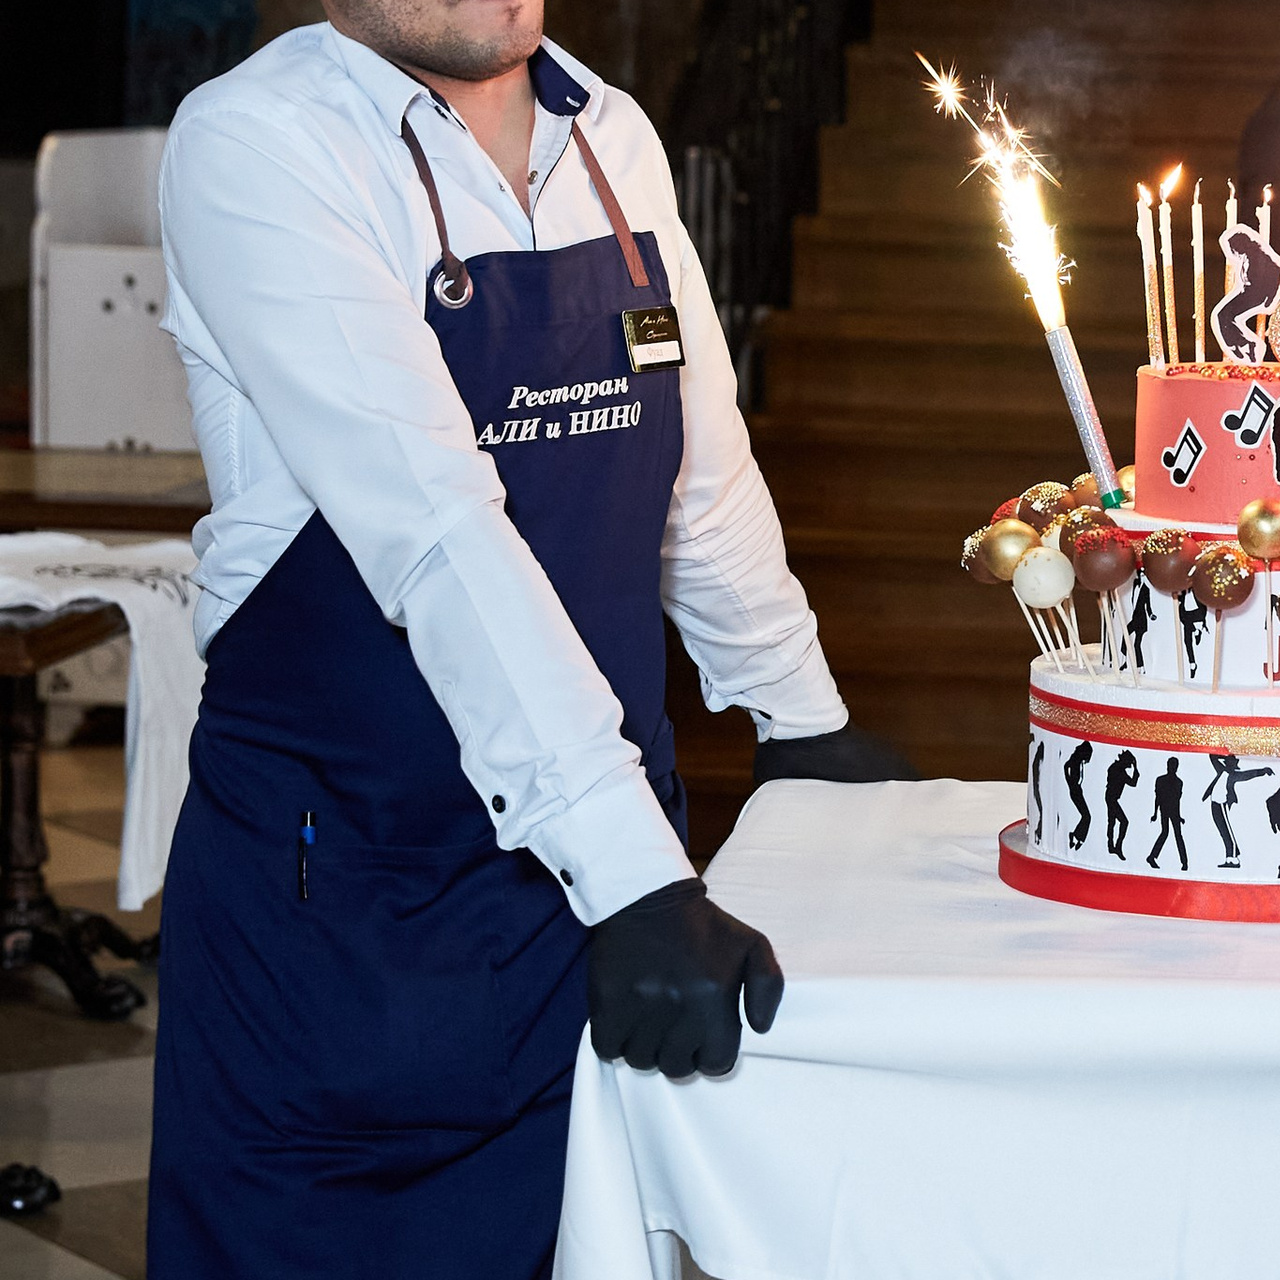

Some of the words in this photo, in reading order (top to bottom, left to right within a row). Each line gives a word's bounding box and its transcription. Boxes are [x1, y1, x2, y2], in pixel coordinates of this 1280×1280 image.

[507, 376, 629, 409] Ресторан
[477, 417, 542, 446] АЛИ
[545, 419, 561, 439] и
[568, 400, 642, 435] НИНО
